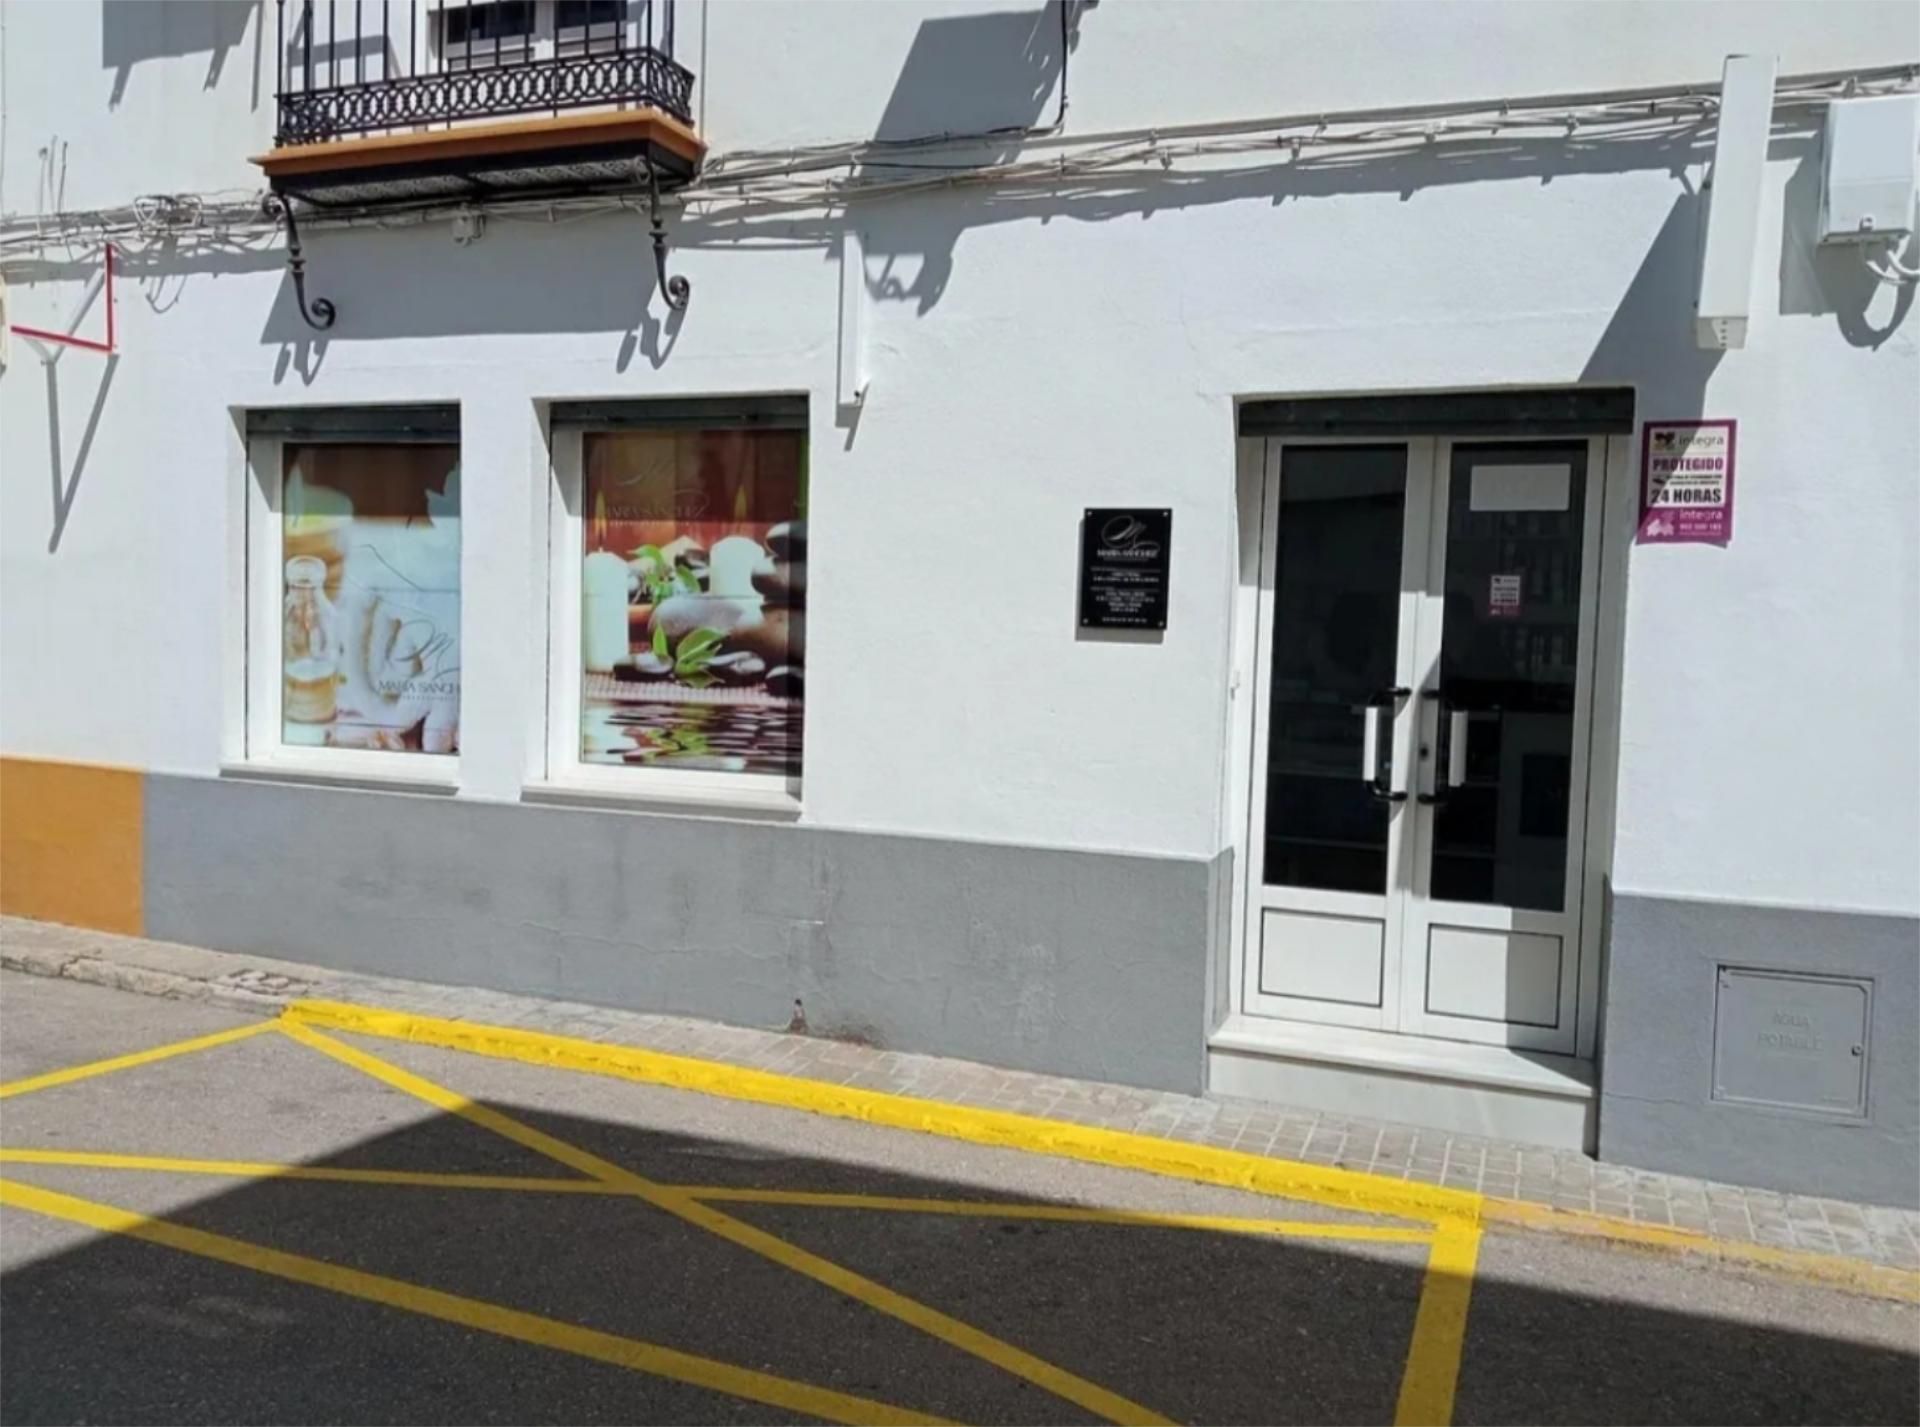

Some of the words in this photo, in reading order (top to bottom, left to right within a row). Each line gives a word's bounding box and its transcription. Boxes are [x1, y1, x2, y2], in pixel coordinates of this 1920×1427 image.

[1679, 434, 1724, 449] integra
[1653, 457, 1724, 471] PROTEGIDO
[1651, 489, 1670, 504] 24
[1673, 488, 1721, 503] HORAS
